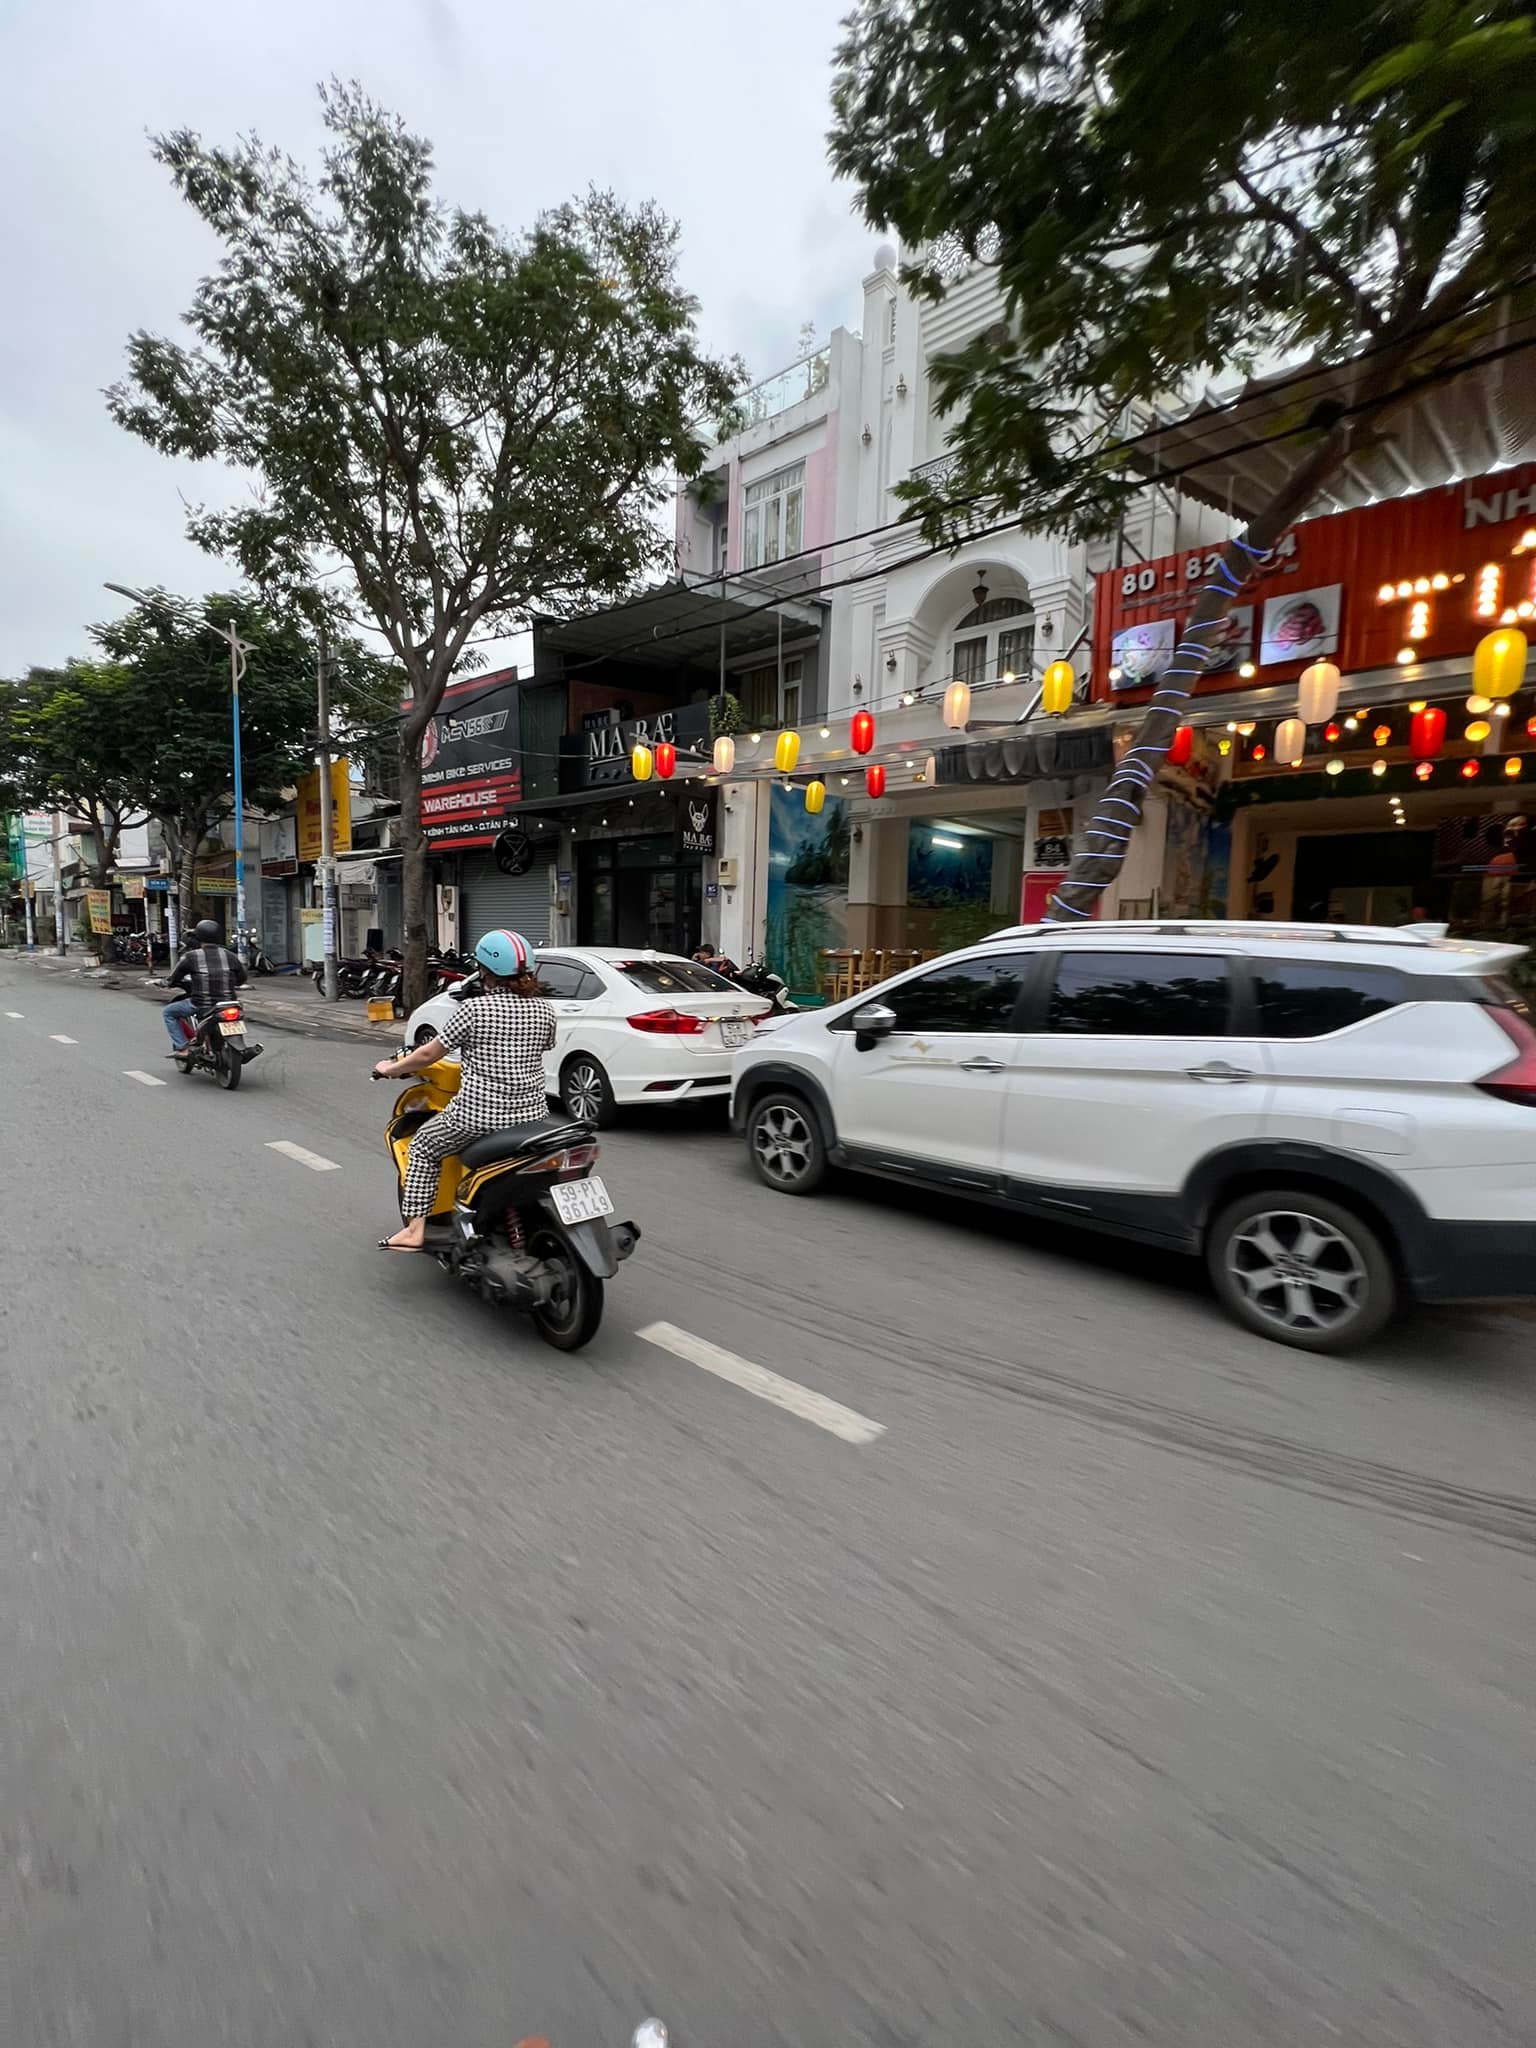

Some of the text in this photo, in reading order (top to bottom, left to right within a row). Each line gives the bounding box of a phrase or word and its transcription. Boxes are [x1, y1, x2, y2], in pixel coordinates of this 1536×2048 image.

[1121, 568, 1156, 596] 80
[1185, 552, 1221, 581] 82
[589, 726, 625, 761] MA
[467, 758, 513, 776] SERVICES
[423, 790, 497, 813] WAREHOUSE
[683, 830, 697, 843] MA
[560, 1182, 597, 1202] 59-P1
[562, 1196, 609, 1220] 361.49
